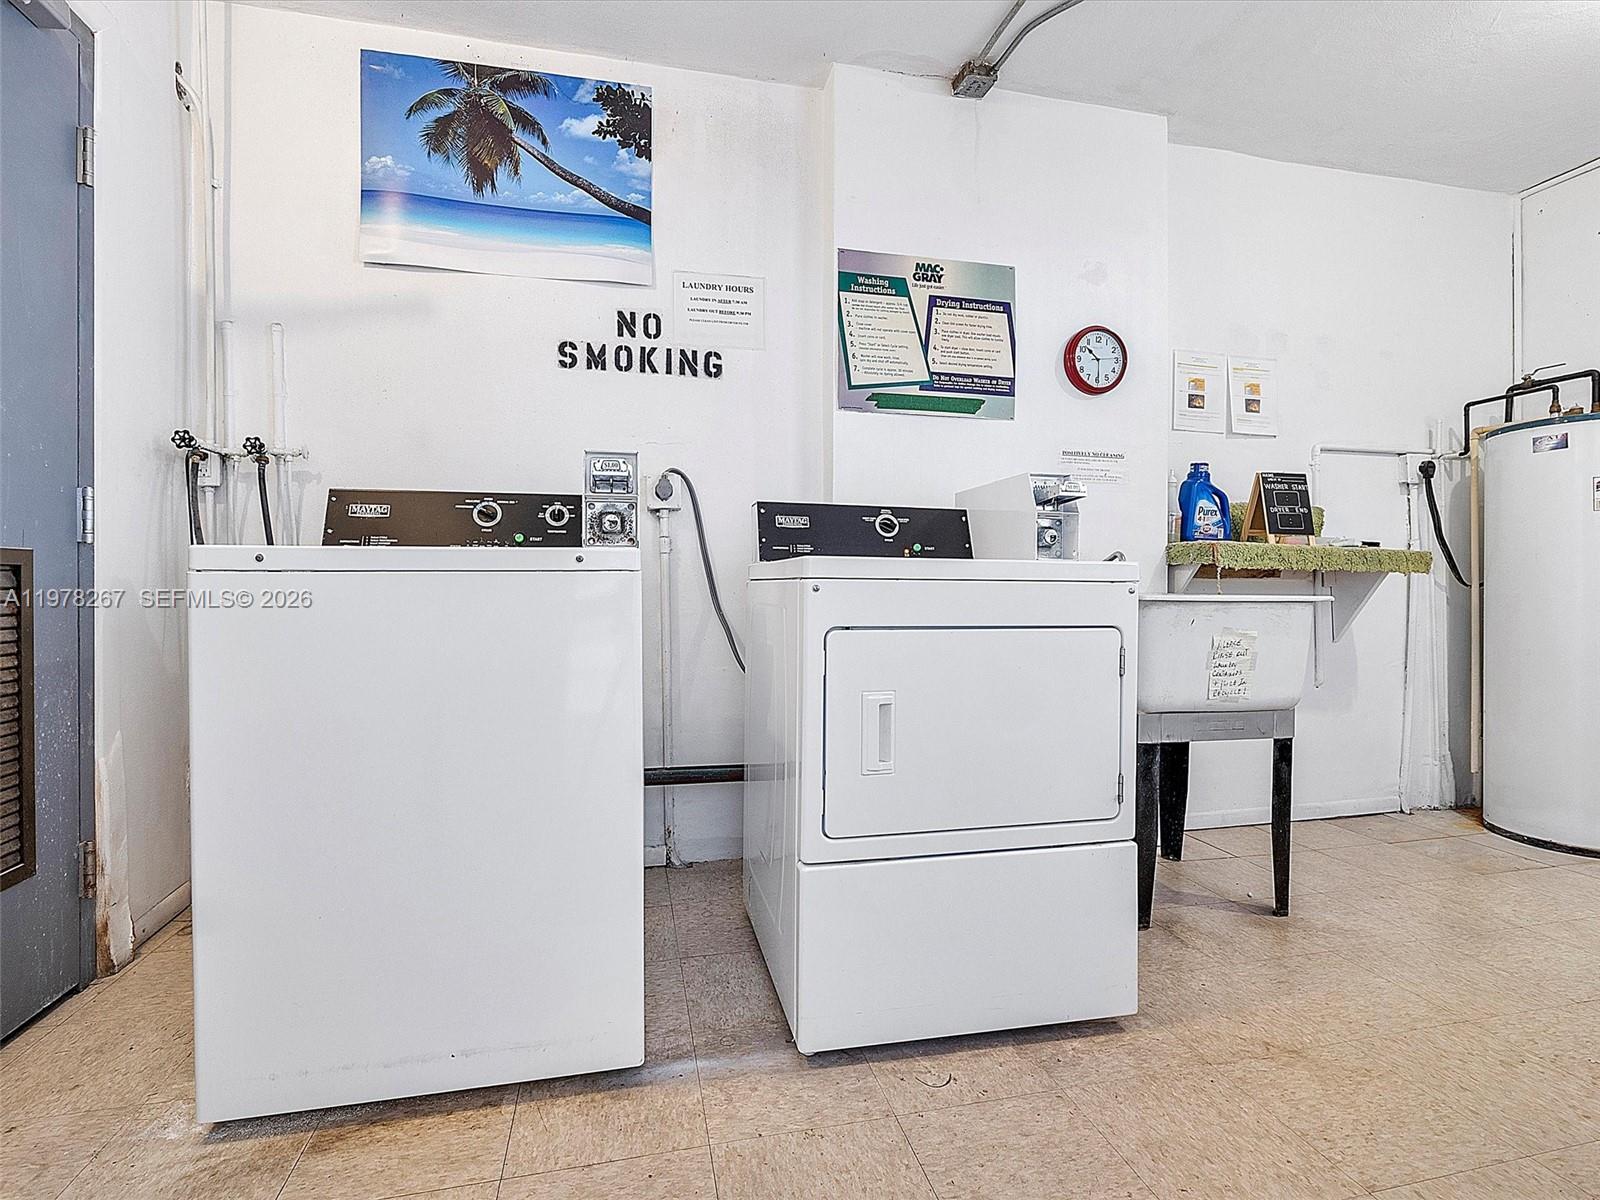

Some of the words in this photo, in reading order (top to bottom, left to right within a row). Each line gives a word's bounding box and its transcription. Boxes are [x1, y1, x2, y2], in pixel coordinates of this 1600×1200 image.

[857, 276, 889, 287] Washing
[913, 273, 944, 283] GRAY
[682, 282, 724, 291] LAUNDRY
[726, 285, 754, 293] HOURS
[850, 284, 896, 294] Instructions
[936, 299, 960, 308] Drying
[962, 301, 1004, 311] Instructions
[617, 310, 662, 339] NO
[558, 341, 723, 379] SMOKING
[351, 505, 388, 514] MAYTAG
[1198, 506, 1218, 517] Purex
